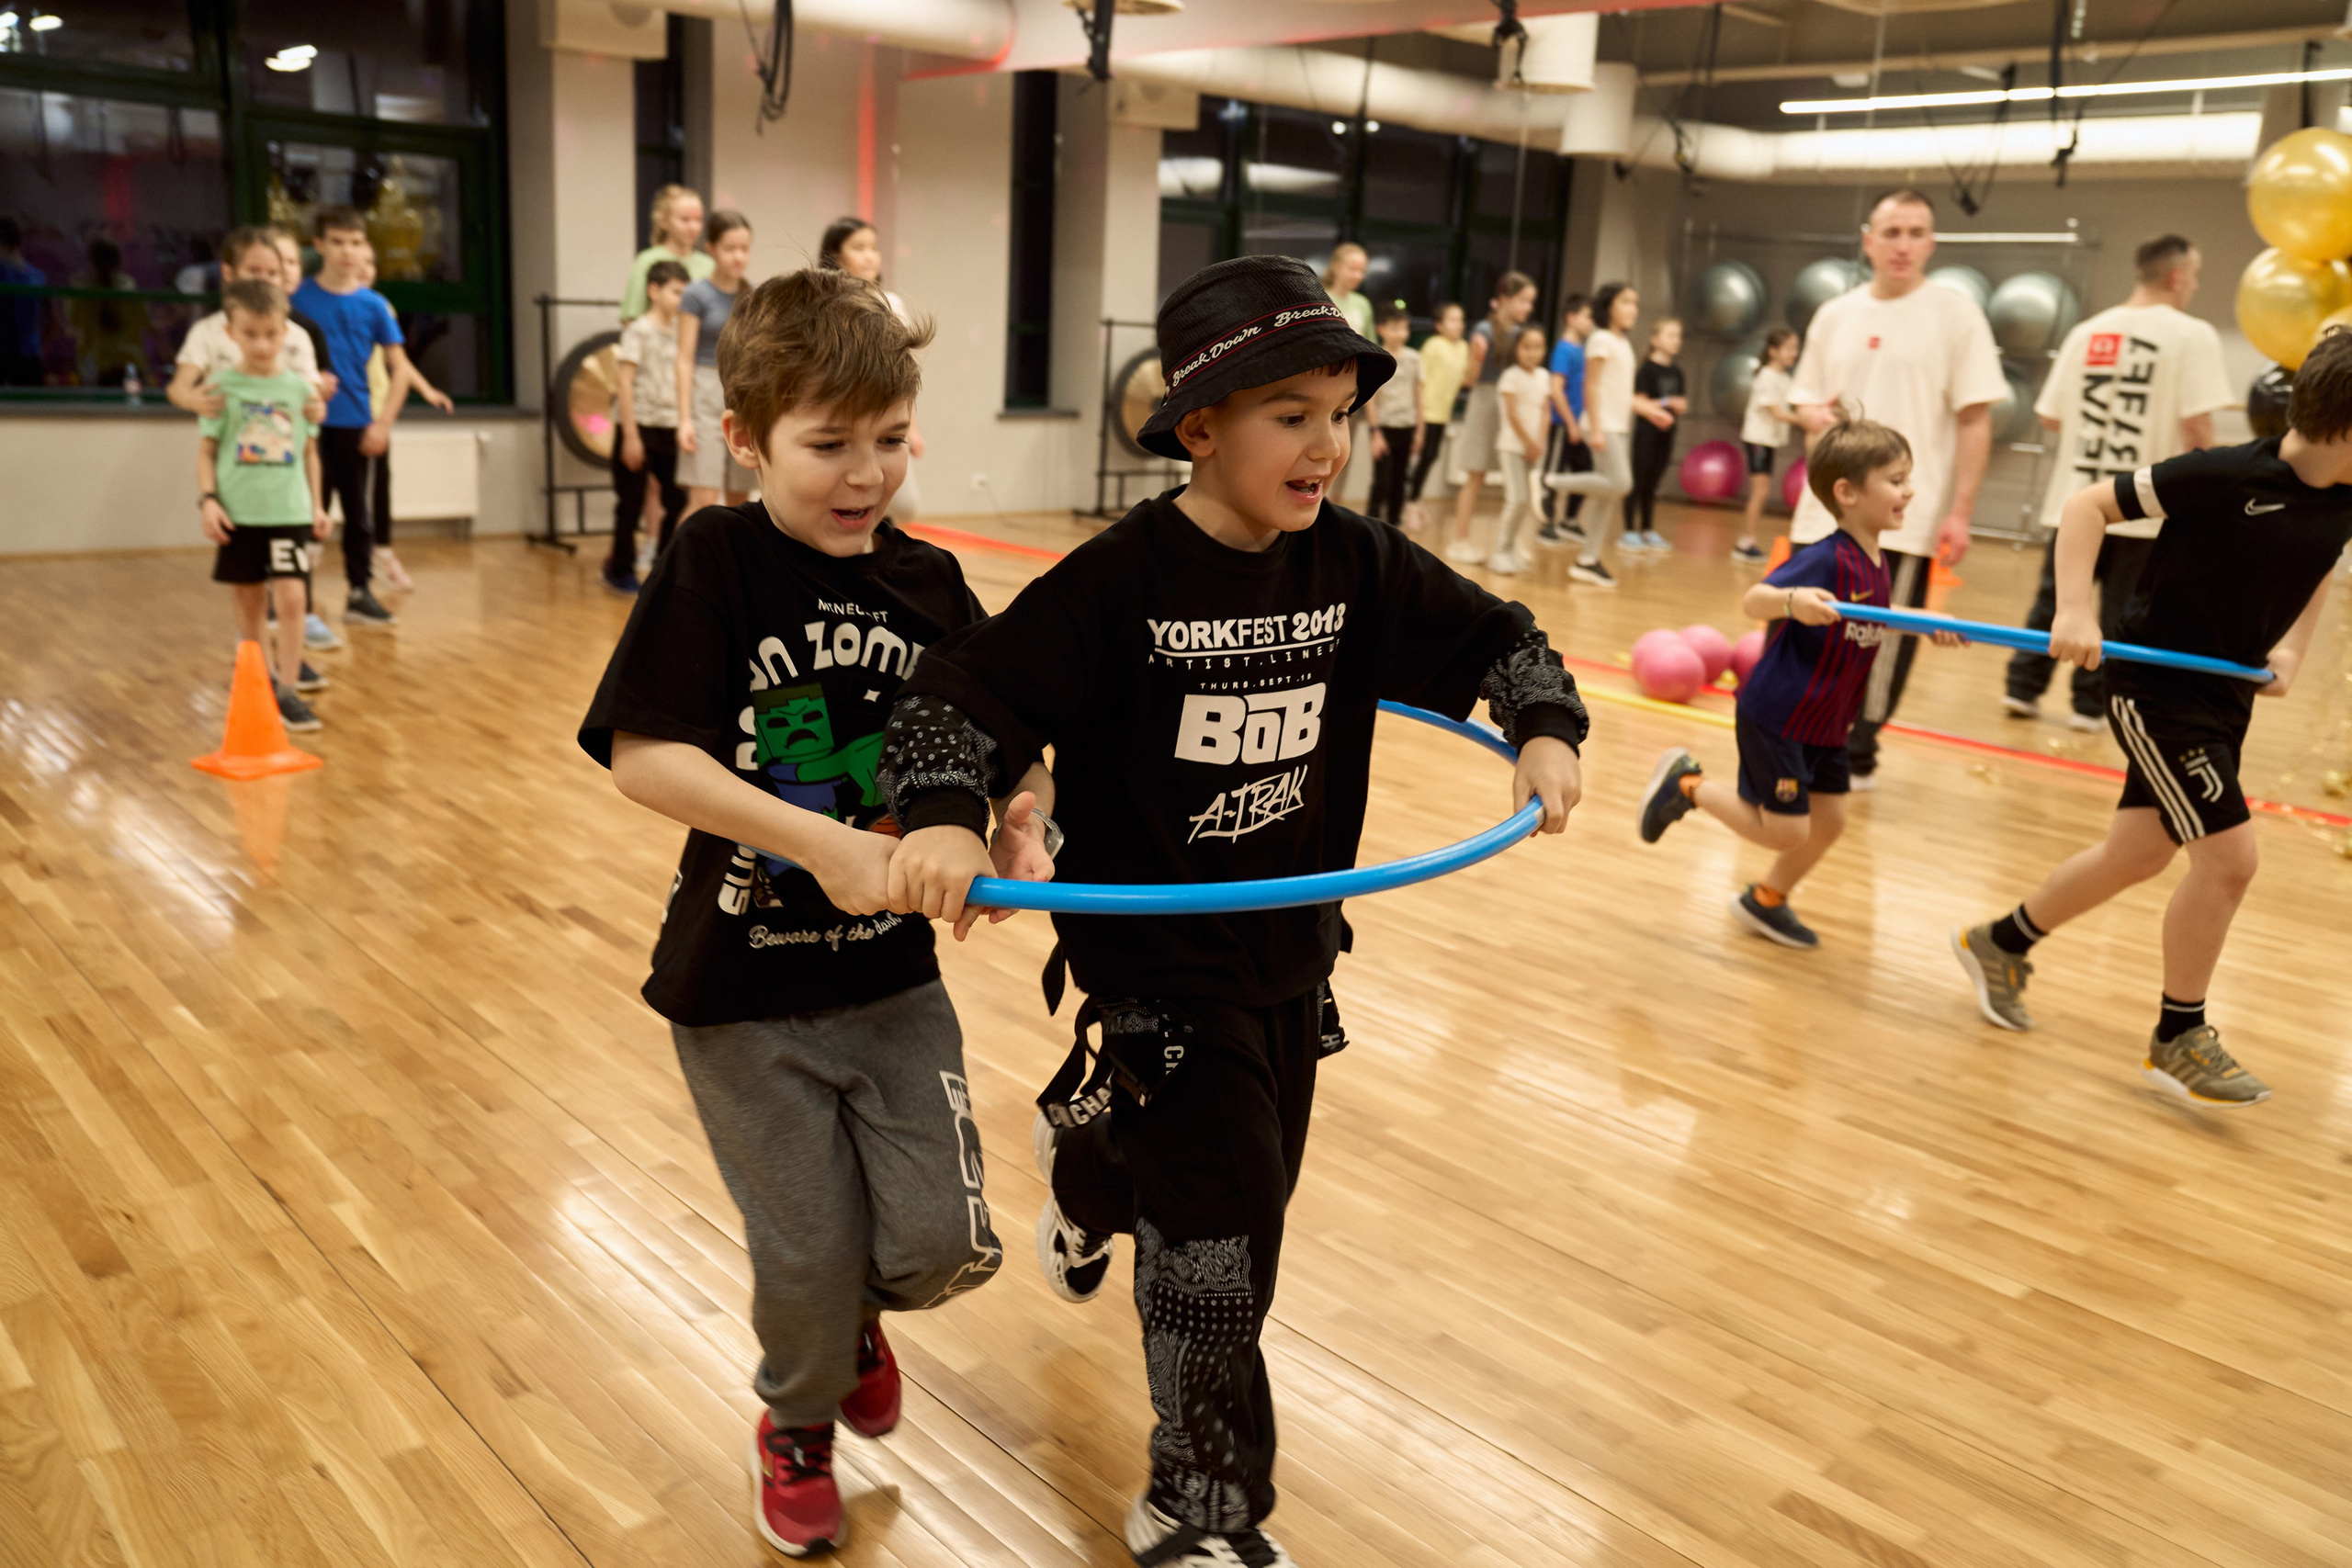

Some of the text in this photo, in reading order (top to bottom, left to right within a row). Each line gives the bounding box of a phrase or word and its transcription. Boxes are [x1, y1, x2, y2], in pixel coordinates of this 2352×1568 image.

[1147, 602, 1347, 651] YORKFEST 2013
[1187, 763, 1309, 845] A-TRAK
[748, 924, 822, 950] Beware
[824, 923, 844, 953] of
[845, 922, 876, 942] the
